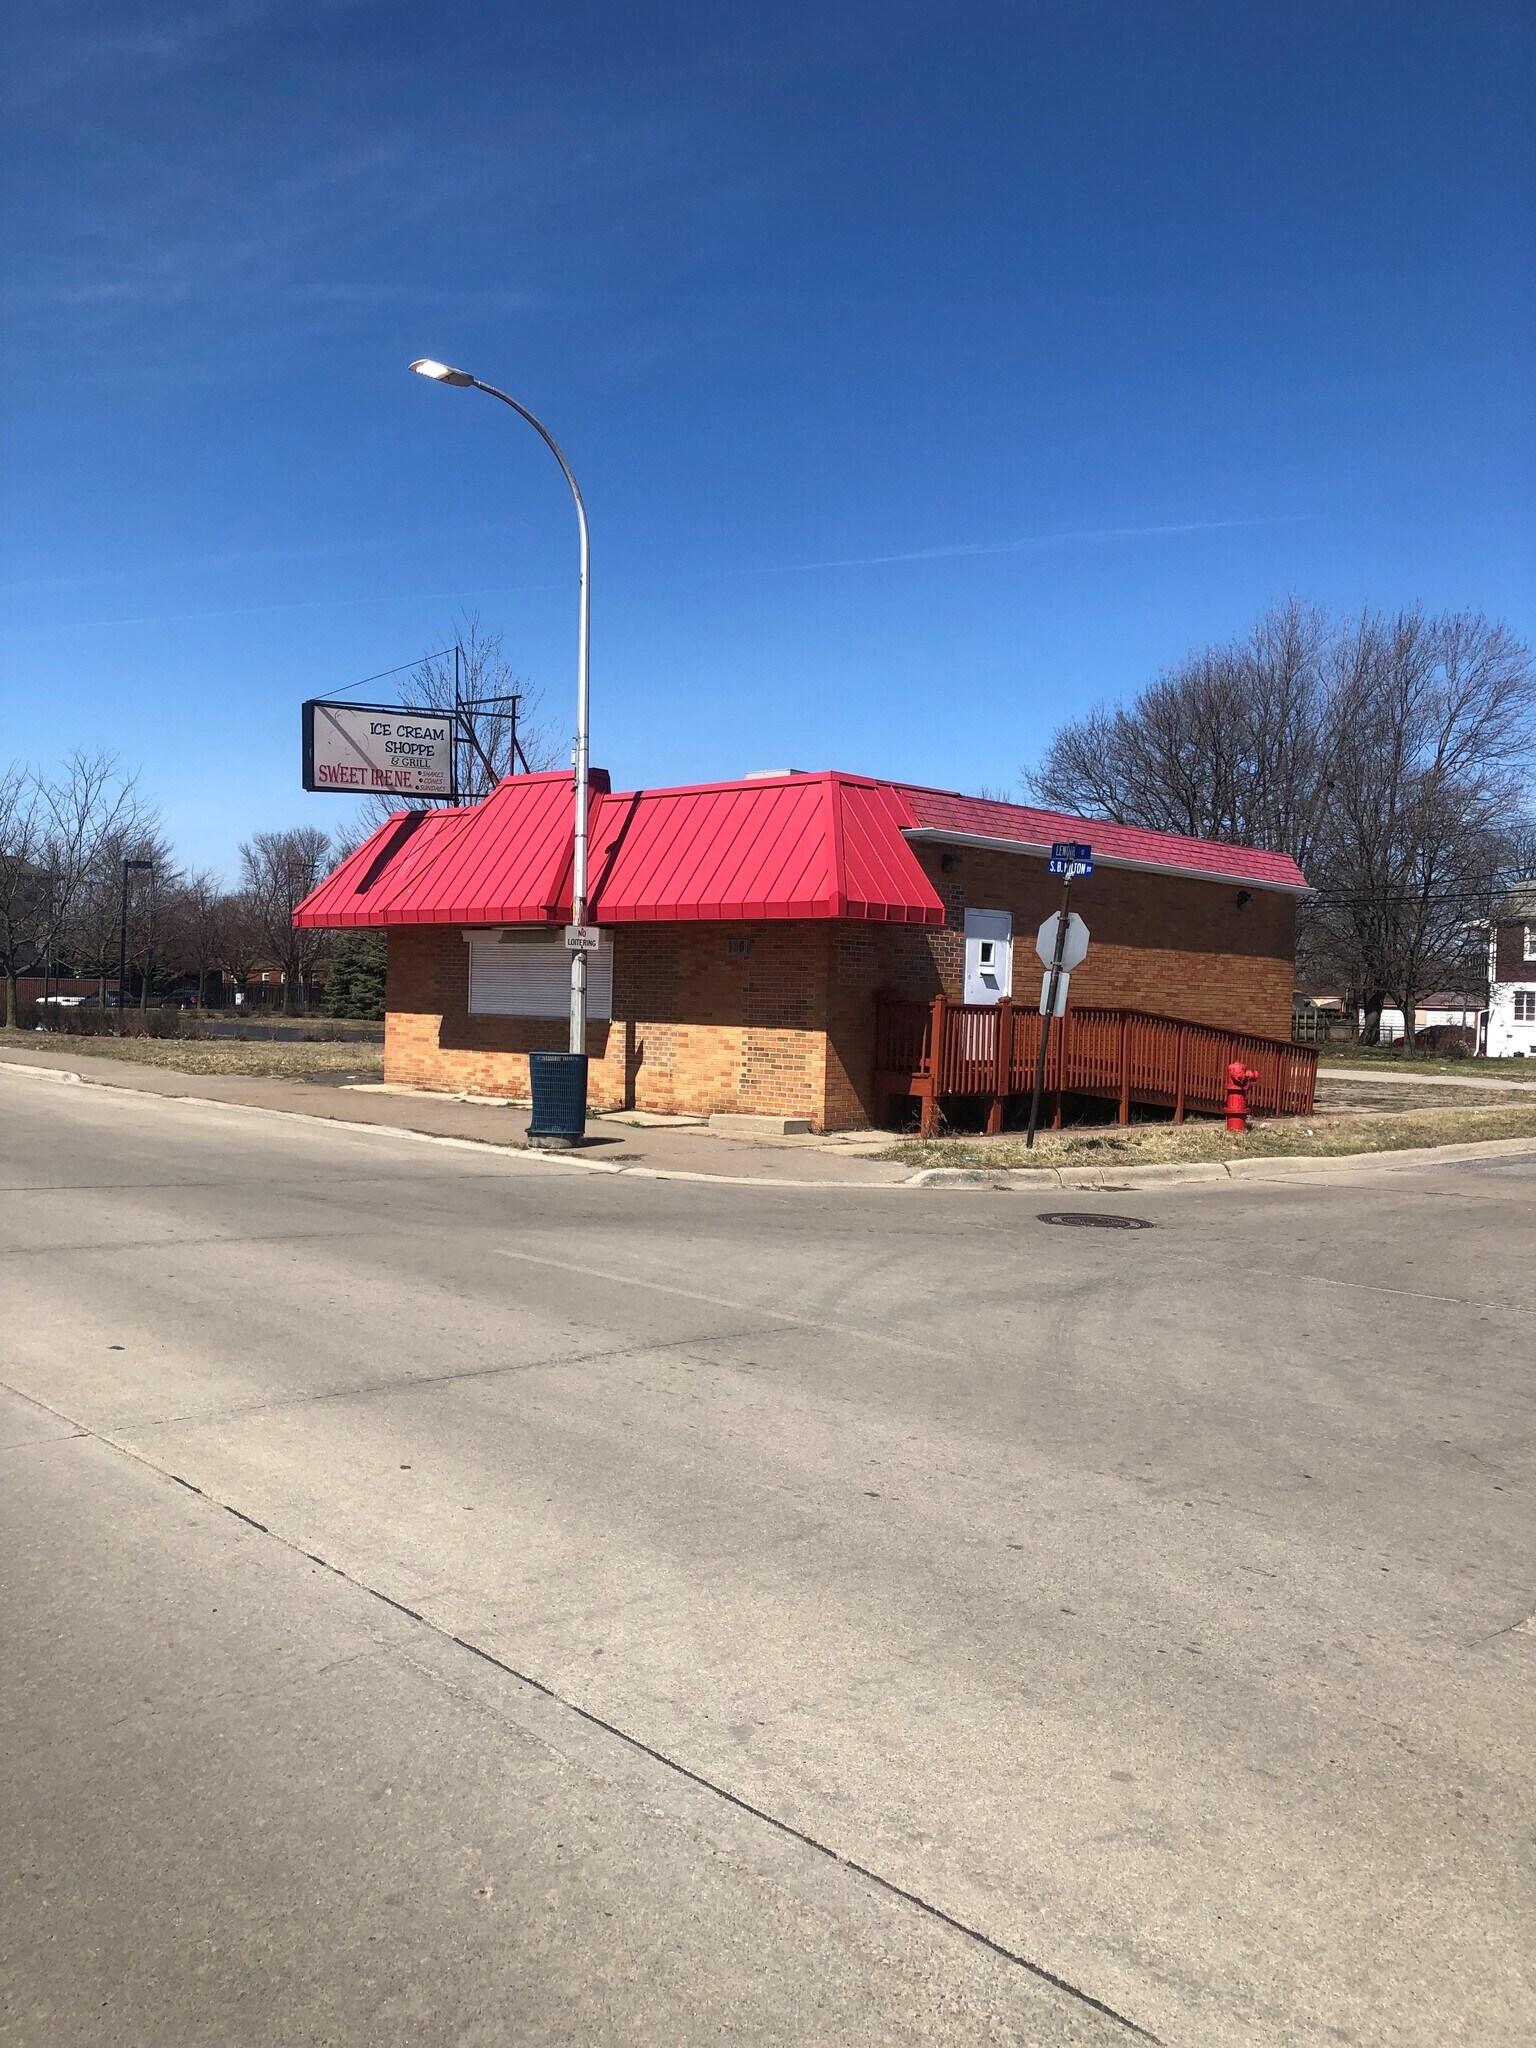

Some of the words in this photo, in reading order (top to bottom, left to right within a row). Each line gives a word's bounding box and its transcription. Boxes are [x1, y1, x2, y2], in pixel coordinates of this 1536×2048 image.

[370, 723, 391, 736] ICE
[397, 725, 444, 740] CREAM
[385, 740, 435, 756] SHOPPE
[391, 757, 399, 766] &
[402, 758, 431, 768] GRILL
[319, 763, 368, 785] SWEET
[371, 769, 412, 788] IRENE
[1050, 860, 1056, 872] S.
[1056, 861, 1063, 873] B.
[568, 939, 596, 947] LOITERING
